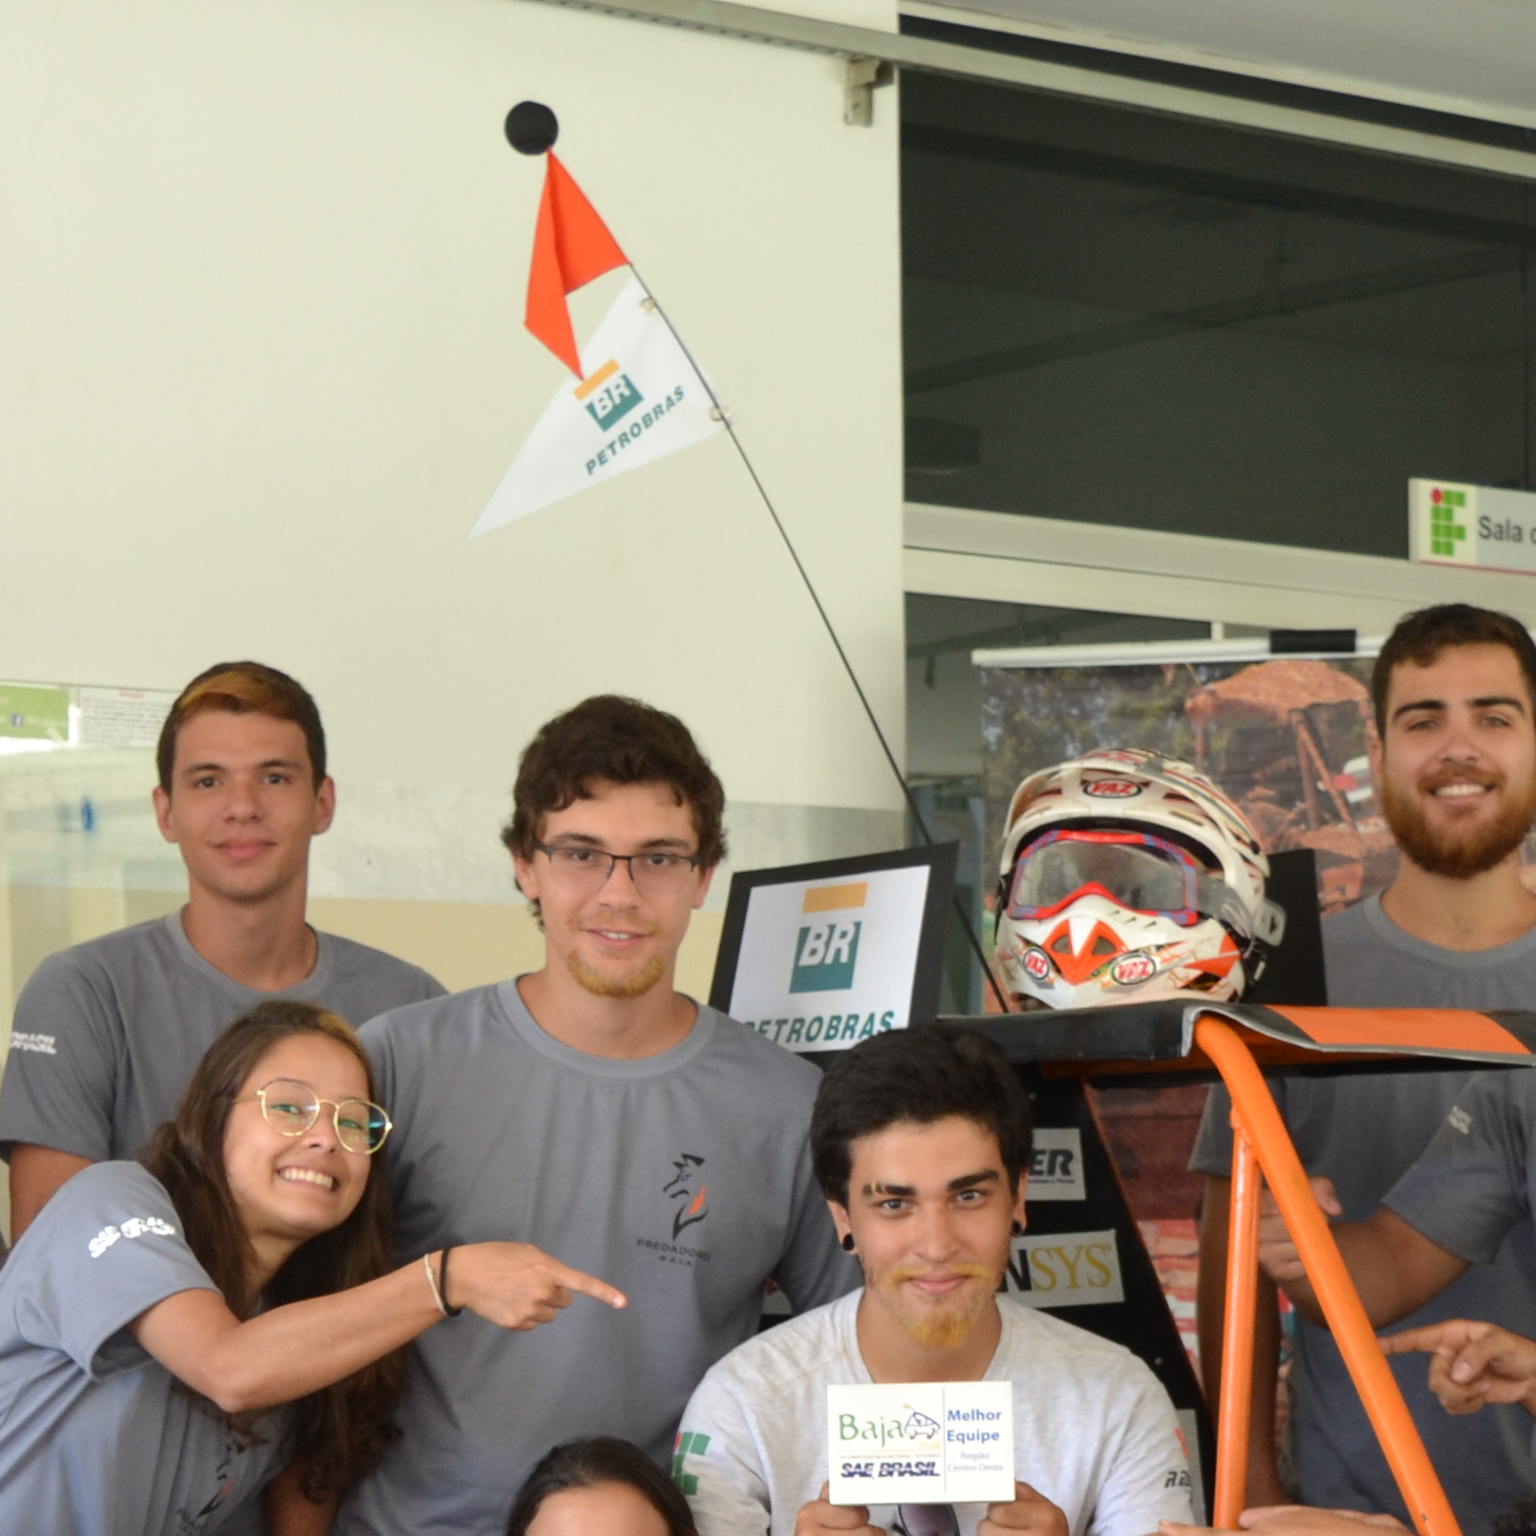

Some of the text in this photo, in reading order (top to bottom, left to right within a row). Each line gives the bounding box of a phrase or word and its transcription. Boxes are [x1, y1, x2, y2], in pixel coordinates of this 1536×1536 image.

[592, 376, 633, 420] BR
[584, 384, 687, 476] PETROBRAS
[1478, 515, 1524, 544] Sala
[798, 921, 858, 968] BR
[838, 1413, 905, 1448] Baja
[946, 1409, 1003, 1423] Melhor
[946, 1429, 1001, 1444] Equipe
[840, 1460, 941, 1479] SAE BRASIL
